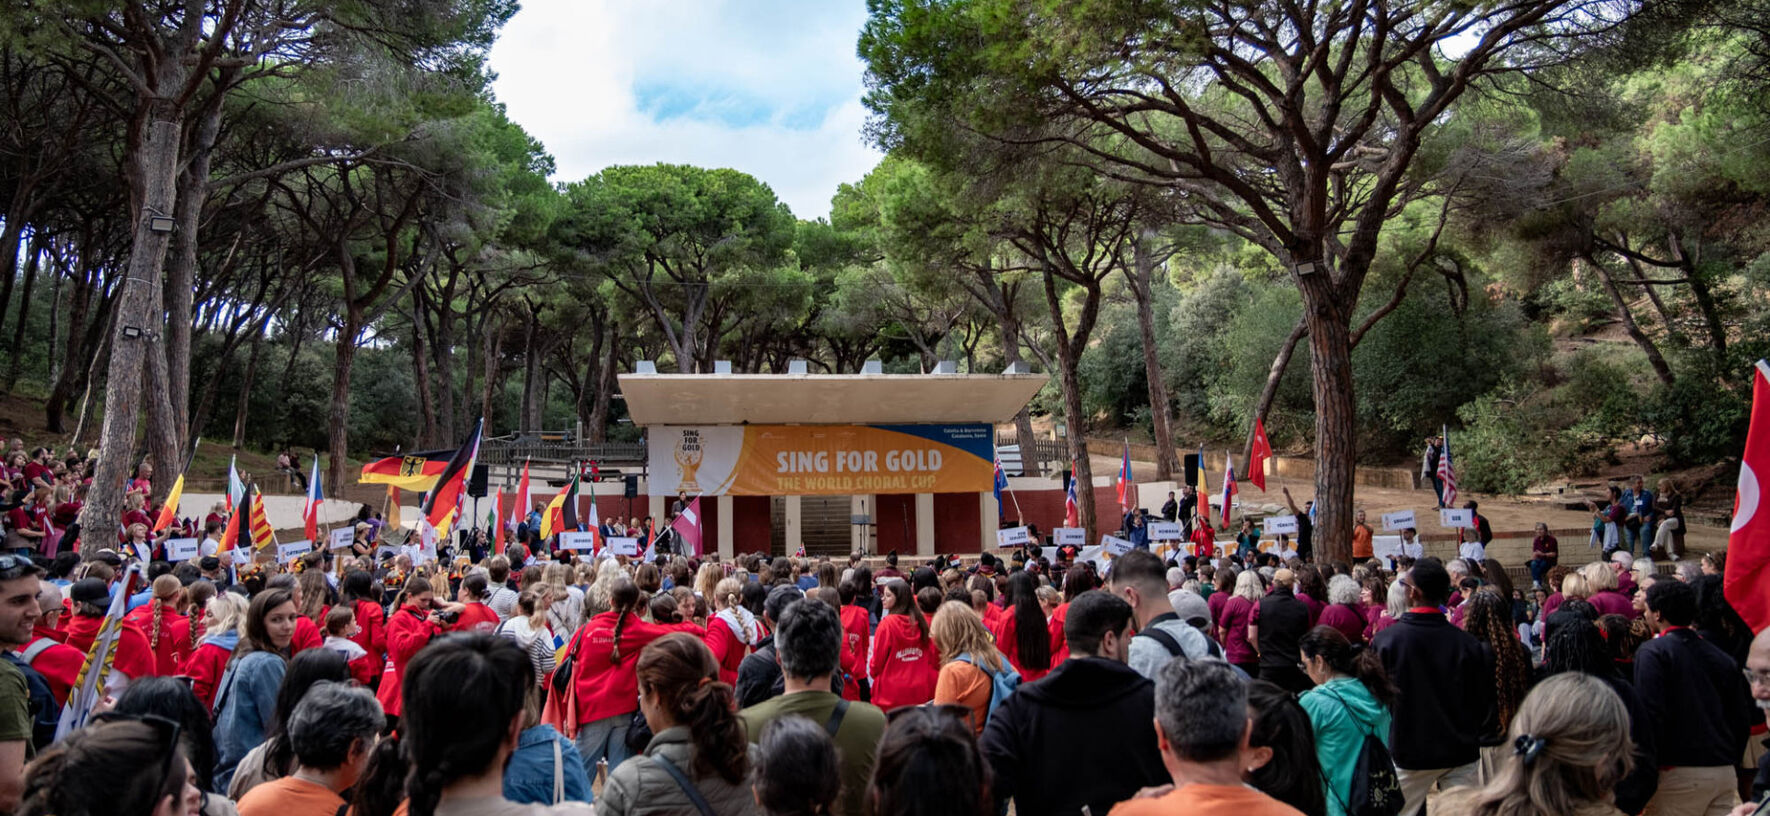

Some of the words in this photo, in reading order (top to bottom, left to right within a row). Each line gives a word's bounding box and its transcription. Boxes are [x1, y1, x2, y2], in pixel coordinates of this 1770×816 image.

[776, 451, 829, 473] SING
[836, 451, 879, 473] FOR
[886, 449, 942, 472] GOLD
[777, 477, 800, 490] THE
[804, 476, 852, 490] WORLD
[855, 475, 907, 490] CHORAL
[911, 475, 936, 489] CUP
